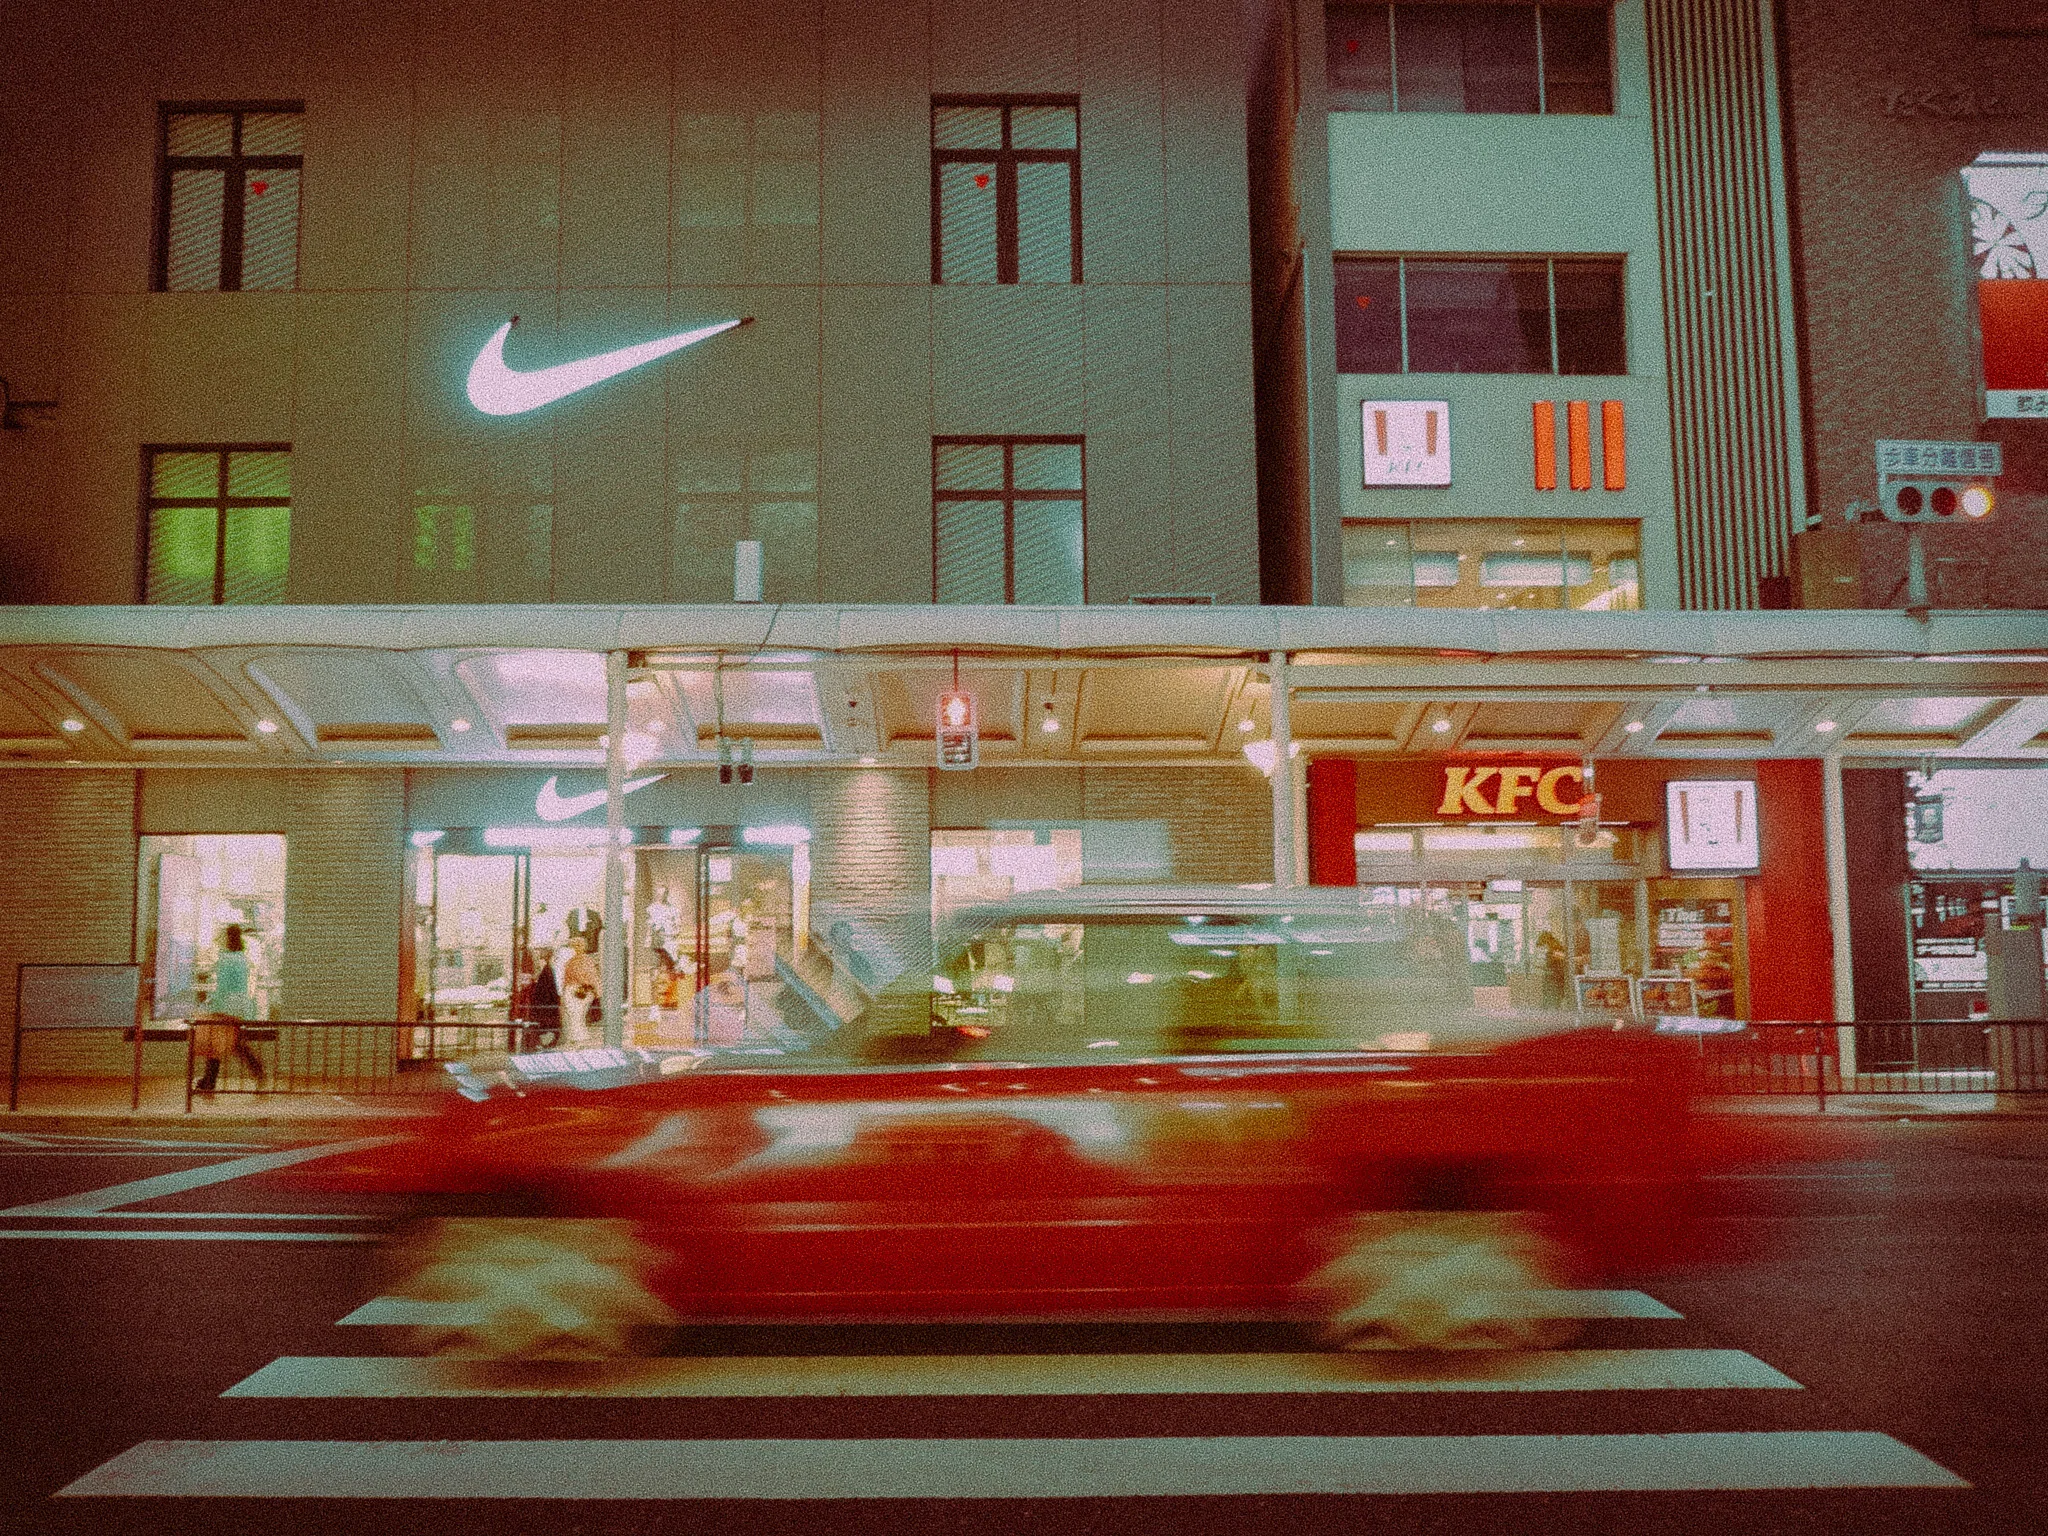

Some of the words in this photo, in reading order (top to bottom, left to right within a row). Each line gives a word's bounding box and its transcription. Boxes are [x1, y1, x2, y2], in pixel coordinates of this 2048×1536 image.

[1884, 447, 1994, 469] 歩車分離信号
[1436, 765, 1584, 815] KFC
